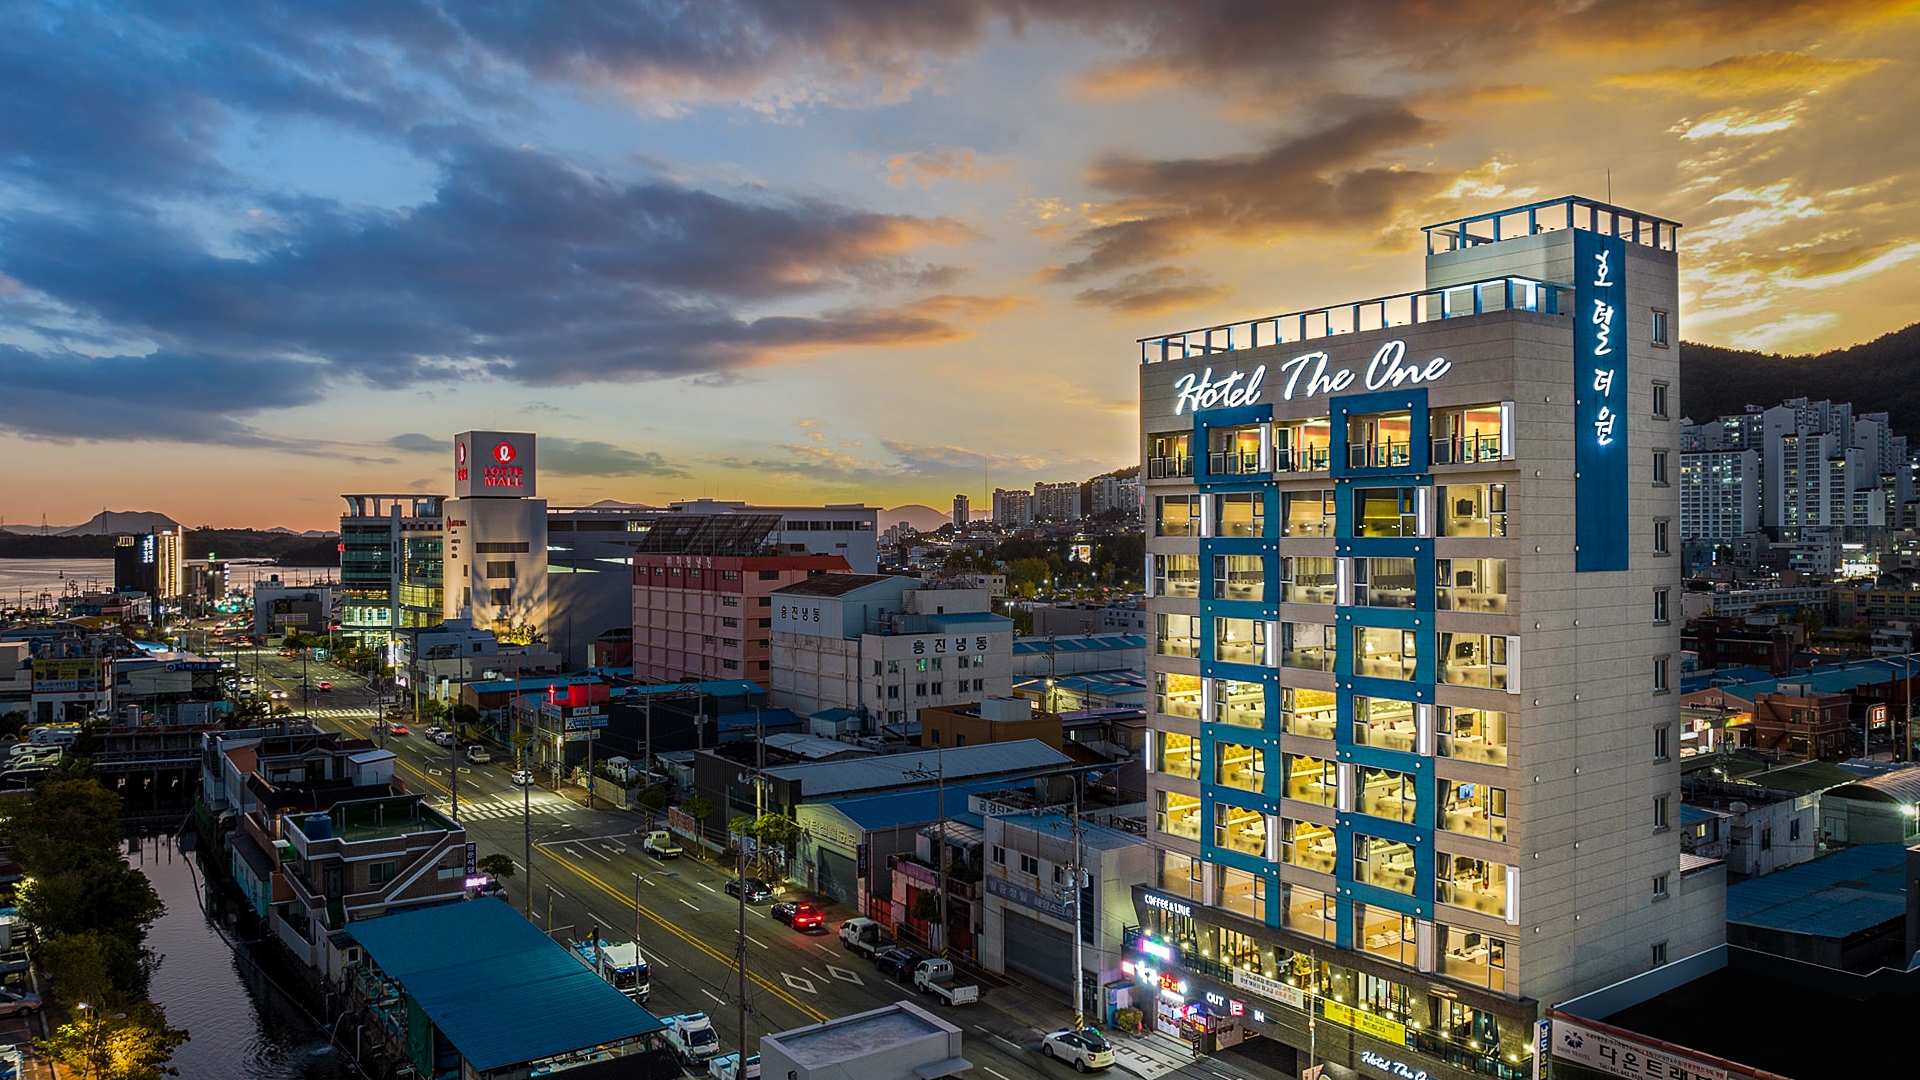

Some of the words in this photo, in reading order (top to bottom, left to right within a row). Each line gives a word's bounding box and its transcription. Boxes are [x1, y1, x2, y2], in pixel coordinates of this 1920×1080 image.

[1175, 365, 1266, 416] Hotel
[1281, 351, 1355, 401] The
[1365, 340, 1451, 390] One
[484, 466, 523, 477] LOTTE
[484, 477, 524, 488] MALL
[780, 604, 820, 623] 흥진냉동
[912, 636, 988, 655] 흥진냉동
[1206, 992, 1225, 1007] OUT
[1253, 1009, 1265, 1023] IN
[1361, 1051, 1391, 1072] Hotel
[1393, 1061, 1414, 1080] The
[1599, 1044, 1713, 1080] 다온트래
